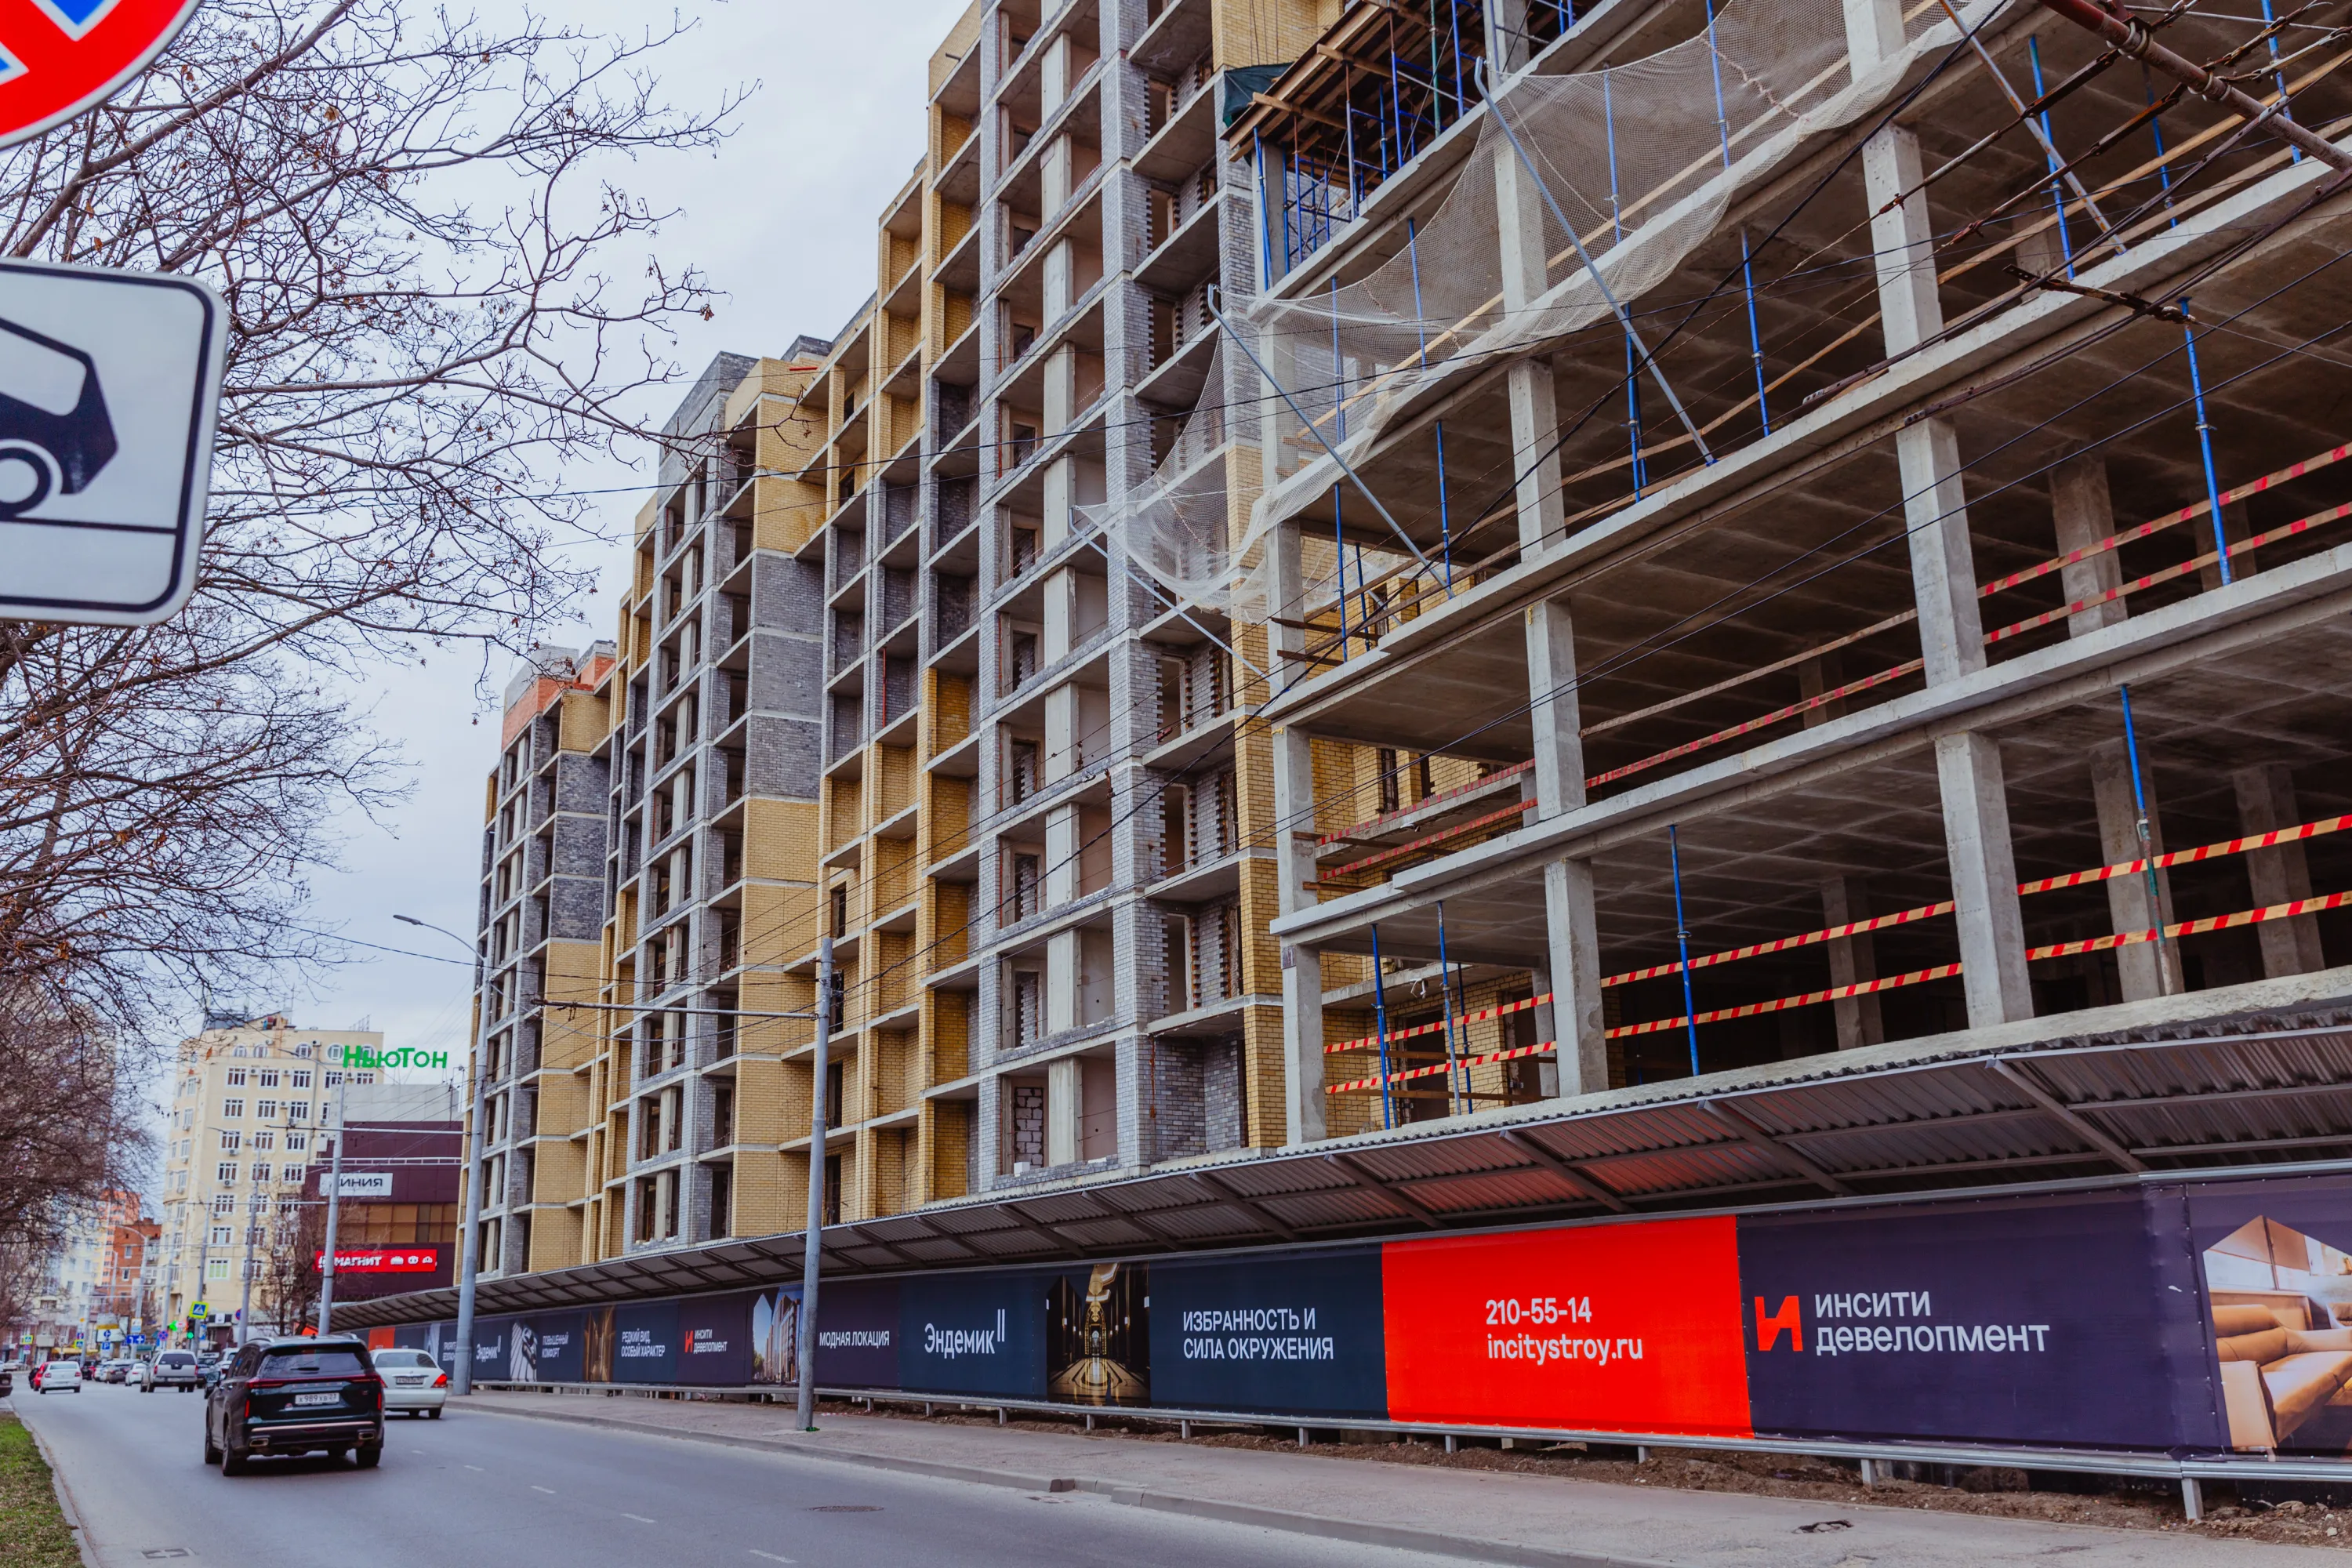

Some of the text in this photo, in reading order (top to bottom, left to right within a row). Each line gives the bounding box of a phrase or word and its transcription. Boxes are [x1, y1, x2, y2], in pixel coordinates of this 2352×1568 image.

[343, 1045, 448, 1069] НьюТон
[330, 1178, 383, 1188] ИНИЯ
[334, 1256, 382, 1266] МАГНИТ
[1486, 1296, 1592, 1325] 210-55-14
[1815, 1291, 1931, 1318] ИНСИТИ
[1183, 1308, 1316, 1332] ИЗБРАННОСТЬ И
[622, 1328, 640, 1345] РЕДКИЙ
[819, 1330, 890, 1348] МОДНАЯ ЛОКАЦИЯ
[924, 1323, 996, 1359] Эндемик
[1183, 1337, 1334, 1359] СИЛА ОКРУЖЕНИЯ
[621, 1343, 666, 1358] ОСОБЫЙ ХАРАКТЕР
[1487, 1333, 1643, 1366] incitystroy.ru
